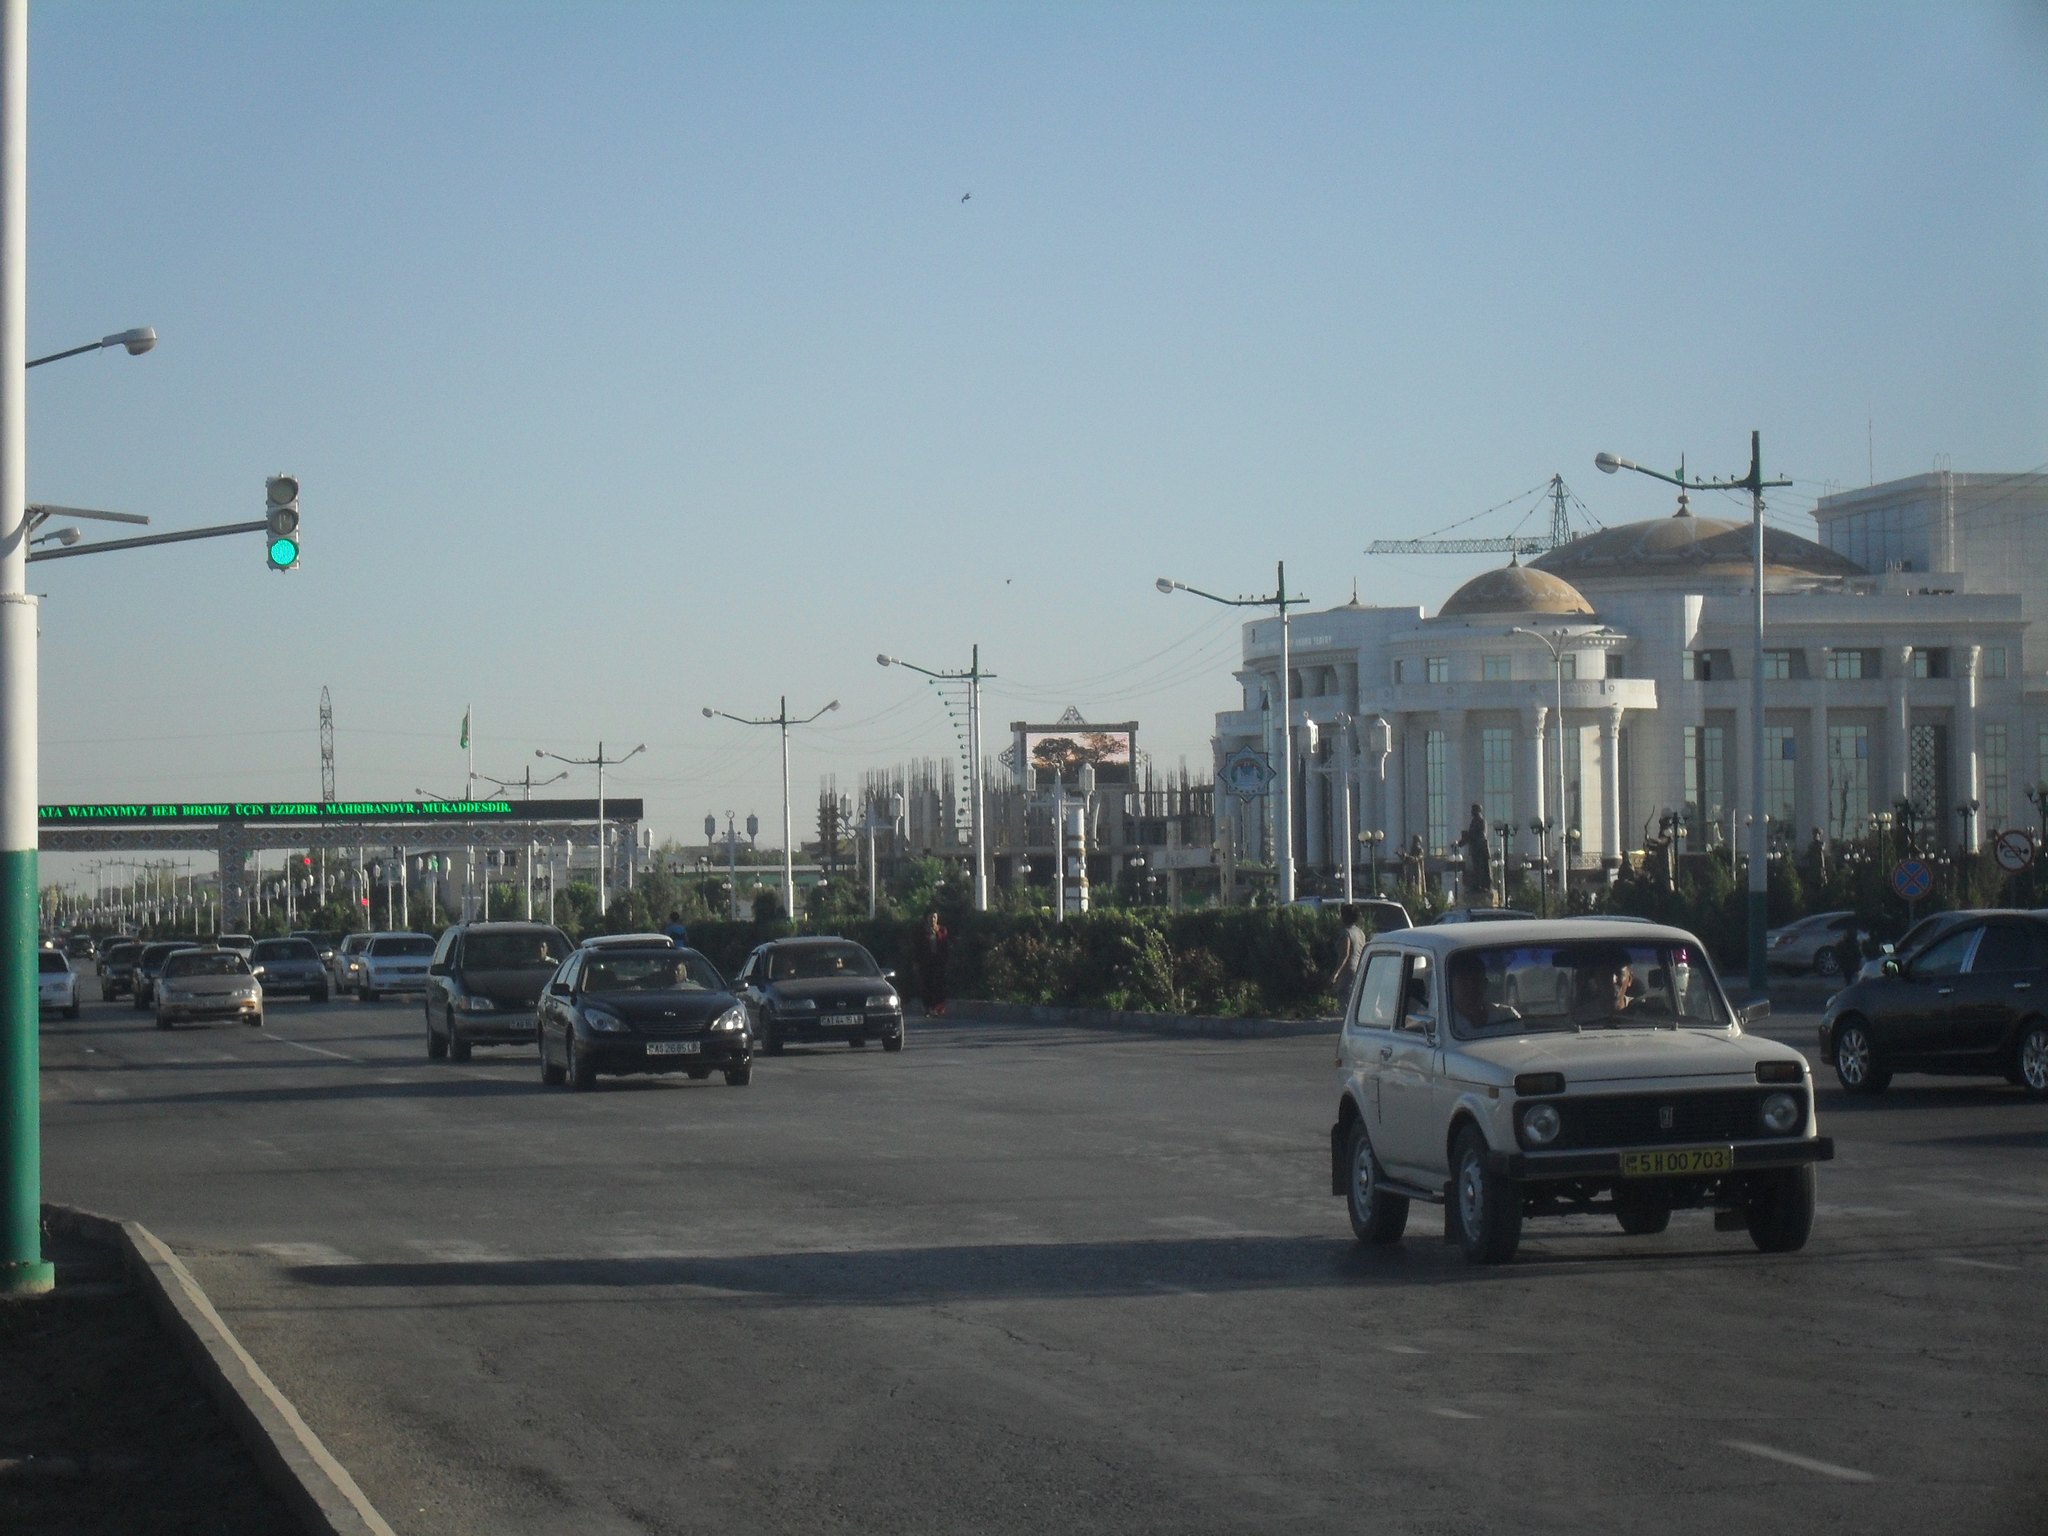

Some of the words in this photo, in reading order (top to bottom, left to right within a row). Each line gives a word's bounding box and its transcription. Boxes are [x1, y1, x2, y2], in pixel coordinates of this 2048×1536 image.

[39, 806, 63, 817] ATA
[67, 806, 147, 817] WATANYMYZ
[152, 805, 177, 816] HER
[182, 805, 230, 816] BIRIMIZ
[423, 803, 511, 813] MUKADDESDIR.
